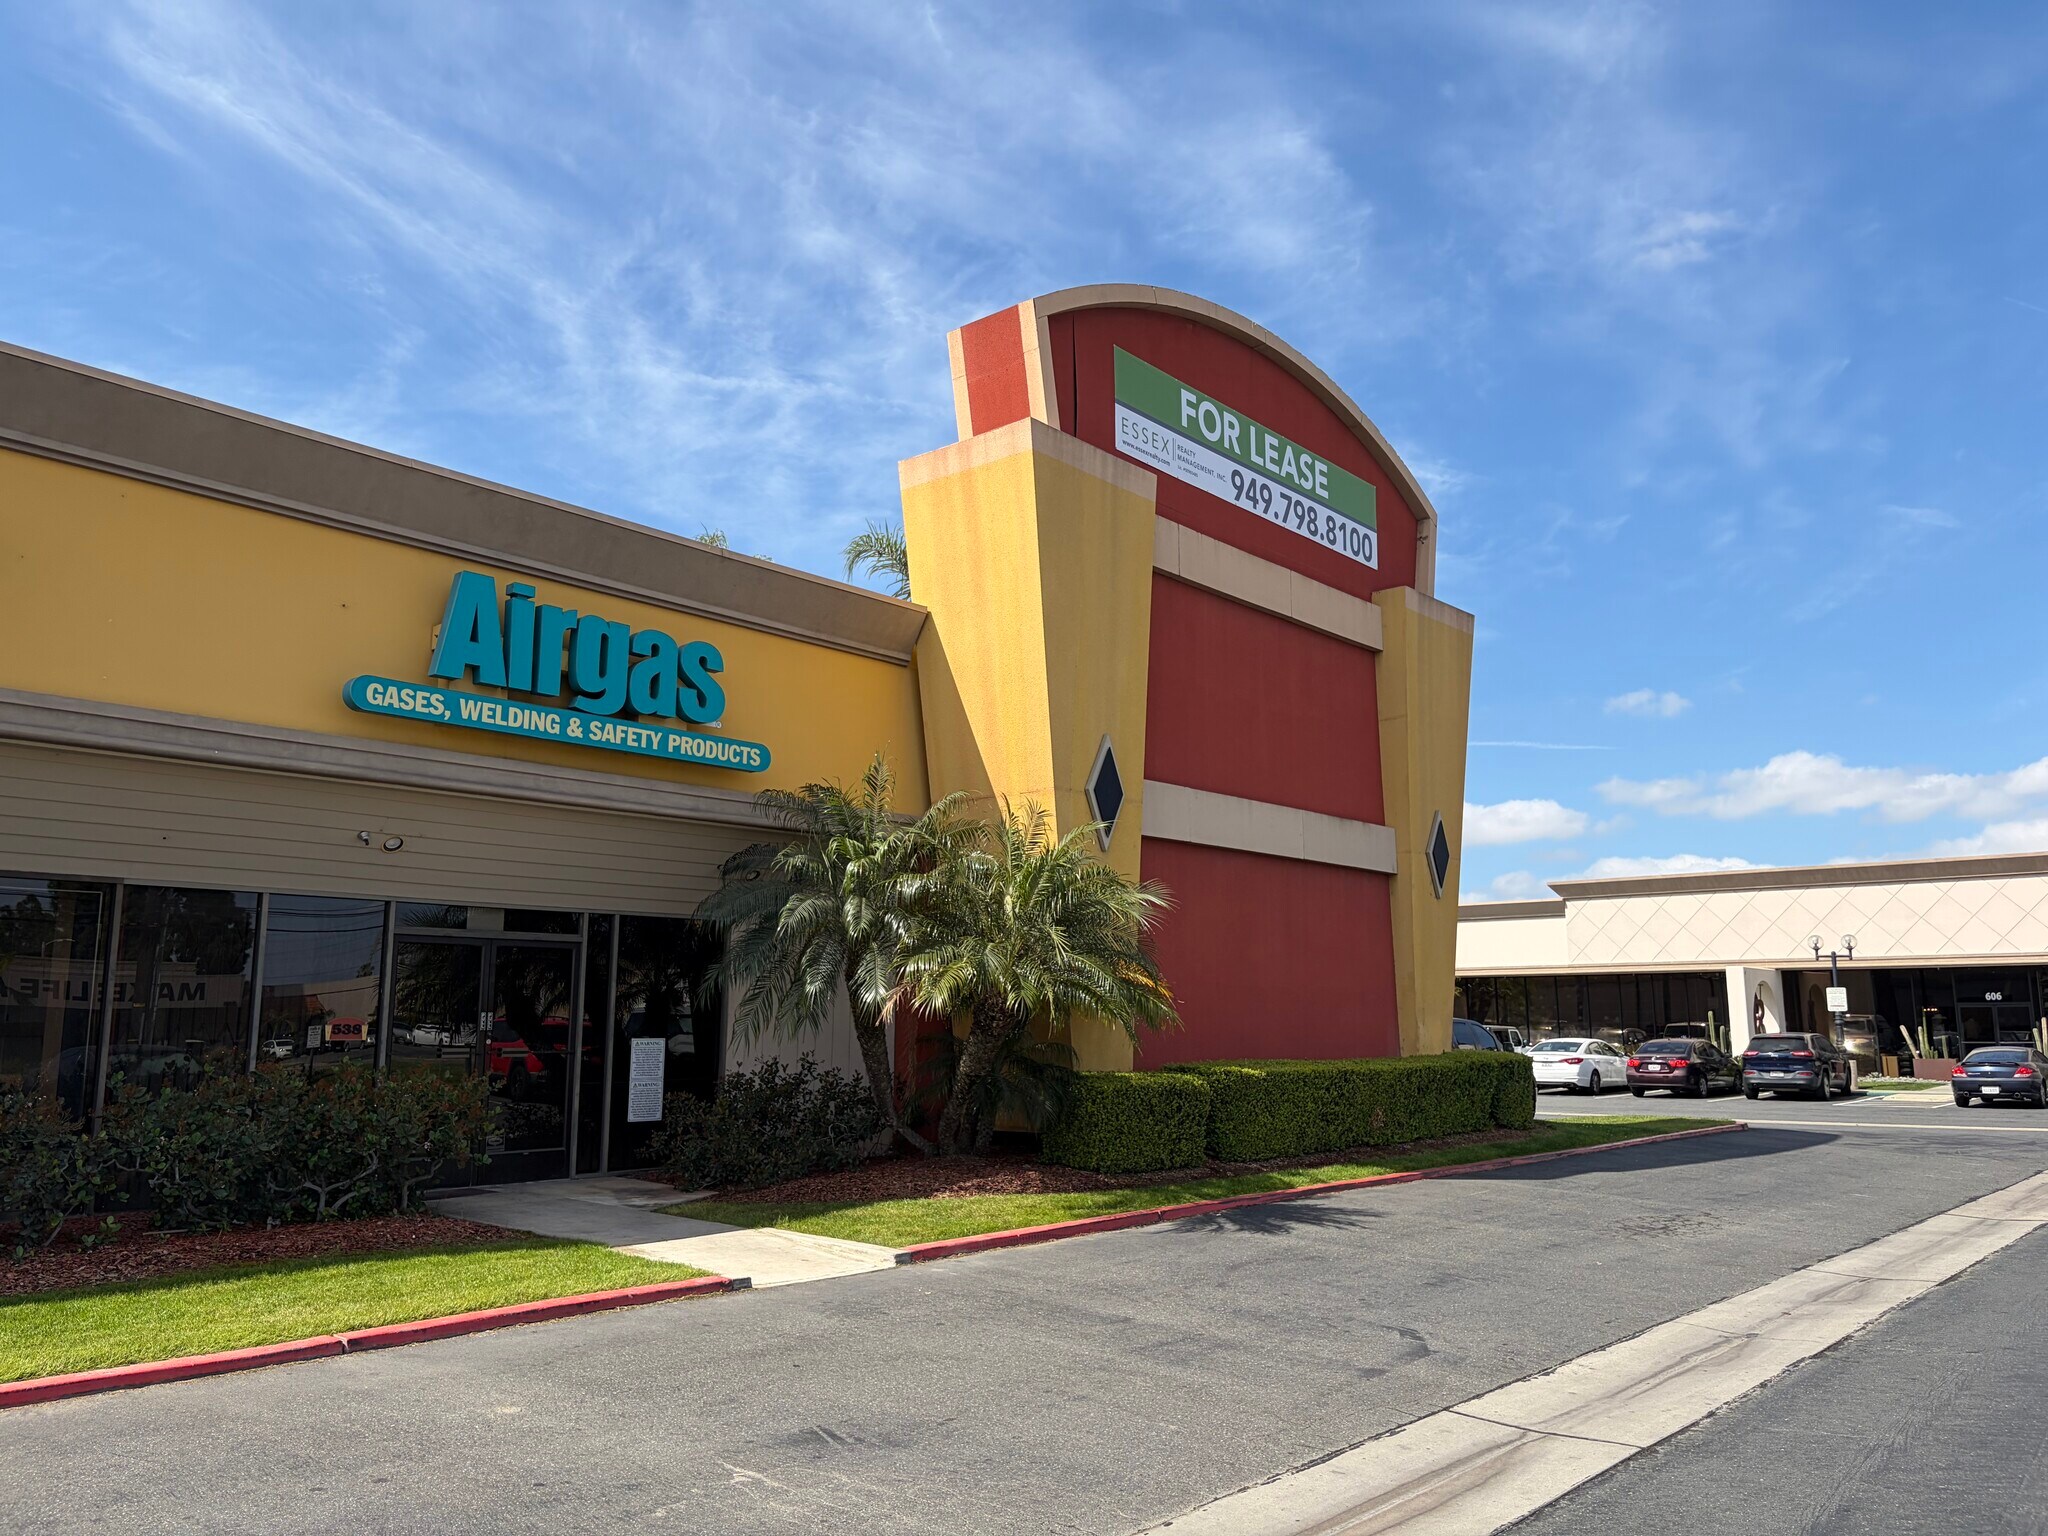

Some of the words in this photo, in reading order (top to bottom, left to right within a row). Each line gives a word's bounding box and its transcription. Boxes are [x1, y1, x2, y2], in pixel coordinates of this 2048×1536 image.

[1121, 416, 1170, 456] ESSEX
[1121, 439, 1171, 467] www.essexrealty.com
[1177, 444, 1197, 459] REALTY
[1180, 387, 1242, 455] FOR
[1249, 425, 1330, 499] LEASE
[1177, 453, 1216, 478] MANAGEMENT,
[1216, 473, 1228, 483] INC.
[1230, 468, 1374, 563] 949.798.8100
[428, 570, 726, 724] Airgas
[365, 682, 451, 720] GASES,
[459, 698, 561, 734] WELDING
[566, 715, 584, 740] &
[588, 720, 664, 753] SAFETY
[667, 733, 761, 767] PRODUCTS
[1985, 992, 2003, 1001] 606
